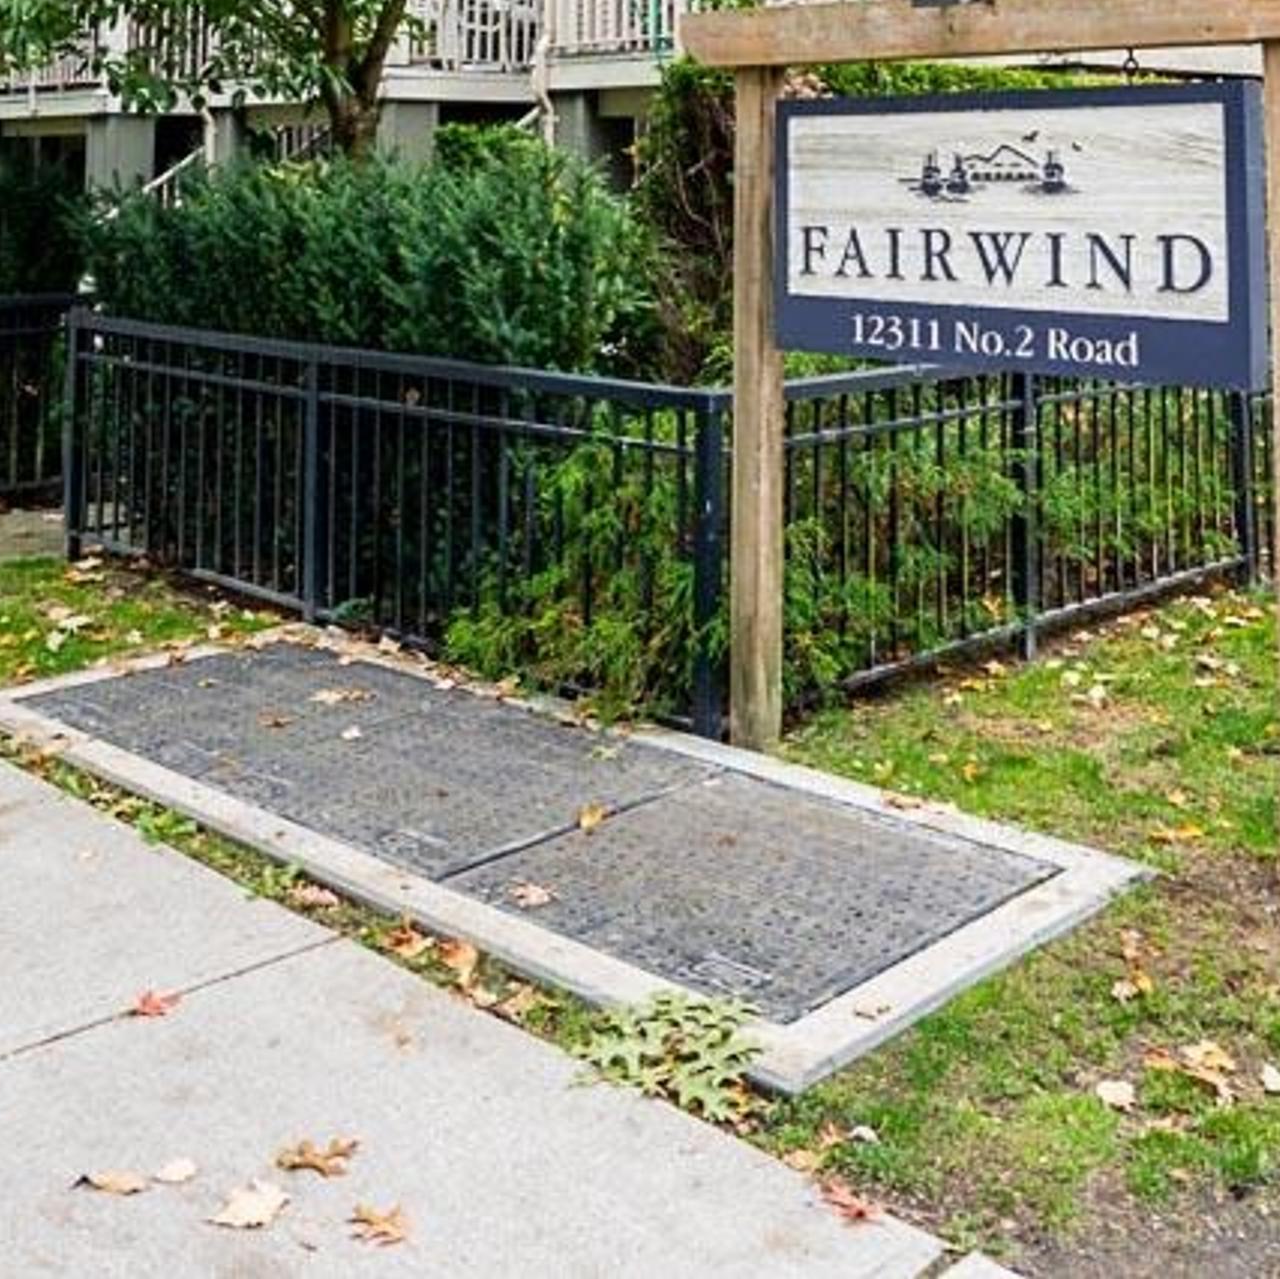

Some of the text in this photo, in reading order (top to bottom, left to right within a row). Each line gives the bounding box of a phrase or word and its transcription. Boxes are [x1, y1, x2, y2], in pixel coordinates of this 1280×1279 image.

[800, 226, 1212, 293] FAIRWIND
[851, 314, 940, 350] 12311
[1047, 328, 1139, 366] Road
